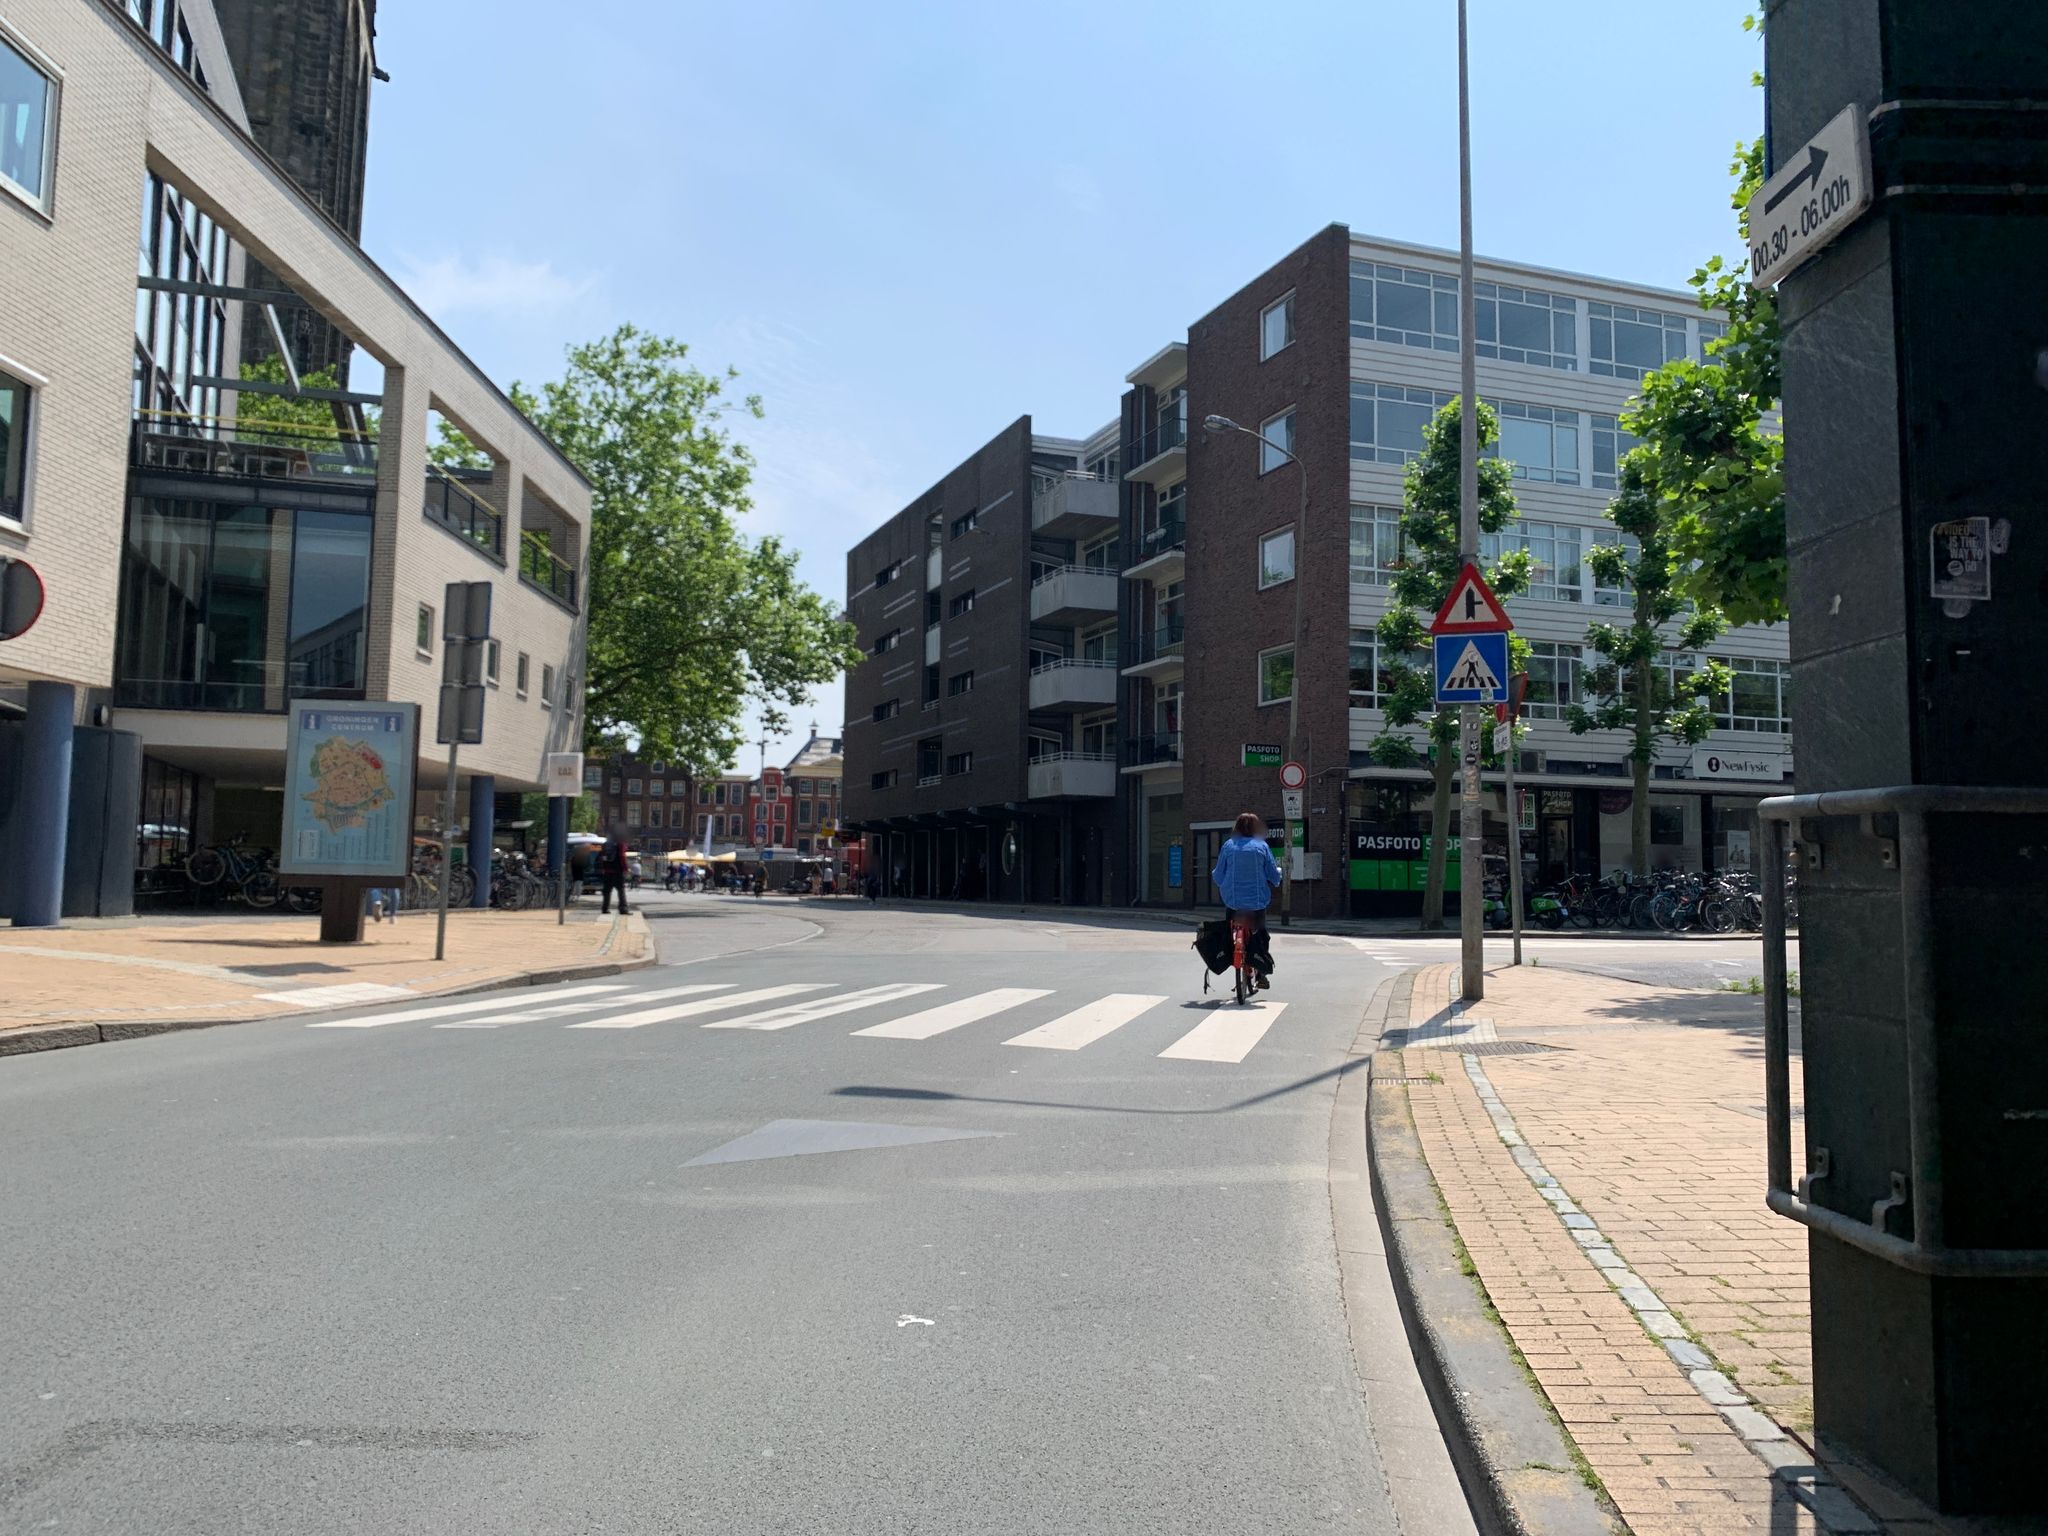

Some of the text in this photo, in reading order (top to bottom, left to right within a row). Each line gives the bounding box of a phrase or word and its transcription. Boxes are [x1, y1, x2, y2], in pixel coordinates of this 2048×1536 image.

[1753, 225, 1788, 276] 00.30
[1801, 175, 1850, 237] 06.00h
[1960, 536, 1978, 548] THE
[1950, 548, 1969, 560] WAY
[1247, 745, 1280, 754] PASFOTO
[1260, 755, 1280, 763] SHOP
[1722, 760, 1770, 774] NewFysic
[1358, 836, 1461, 850] PASFOTO SOP
